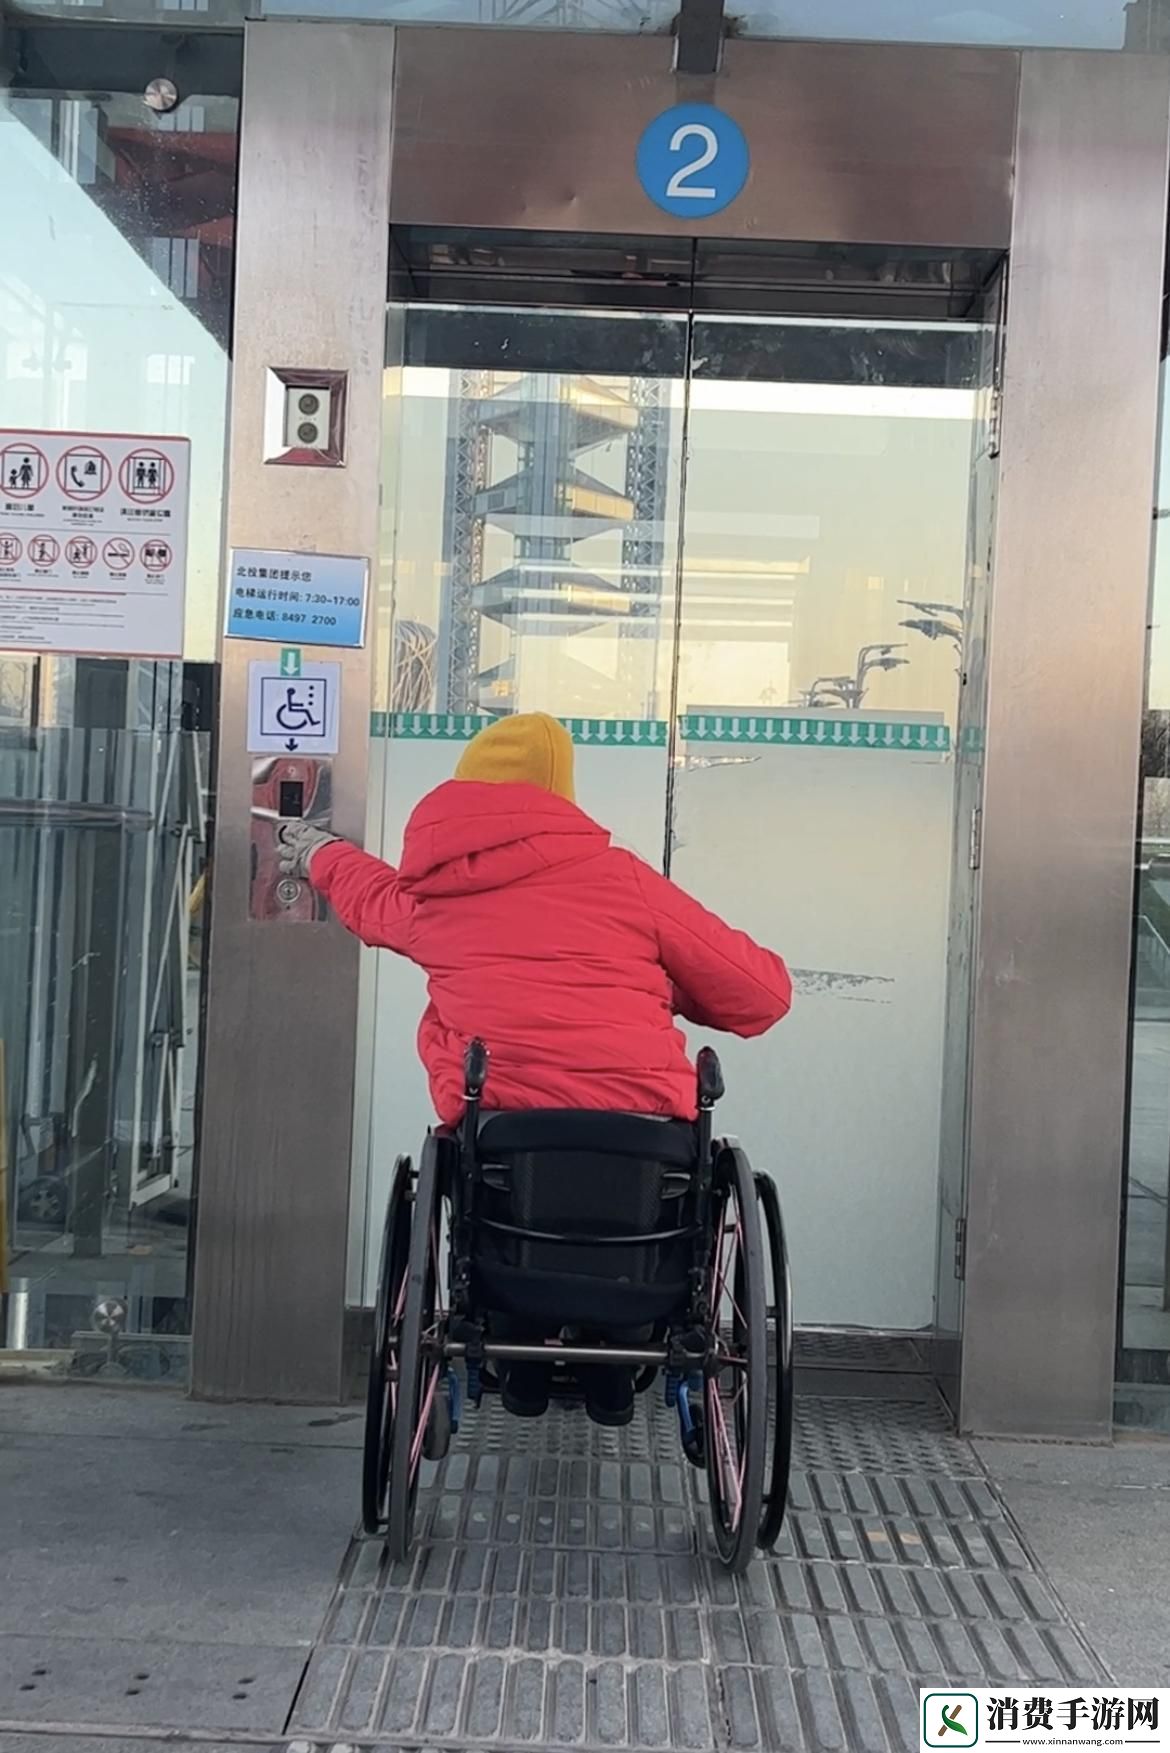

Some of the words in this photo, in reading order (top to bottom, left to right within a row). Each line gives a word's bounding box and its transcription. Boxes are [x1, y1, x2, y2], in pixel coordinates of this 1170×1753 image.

[666, 123, 718, 198] 2
[236, 566, 312, 582] 北投集团提示您
[282, 612, 306, 623] 8497
[311, 615, 337, 626] 2700
